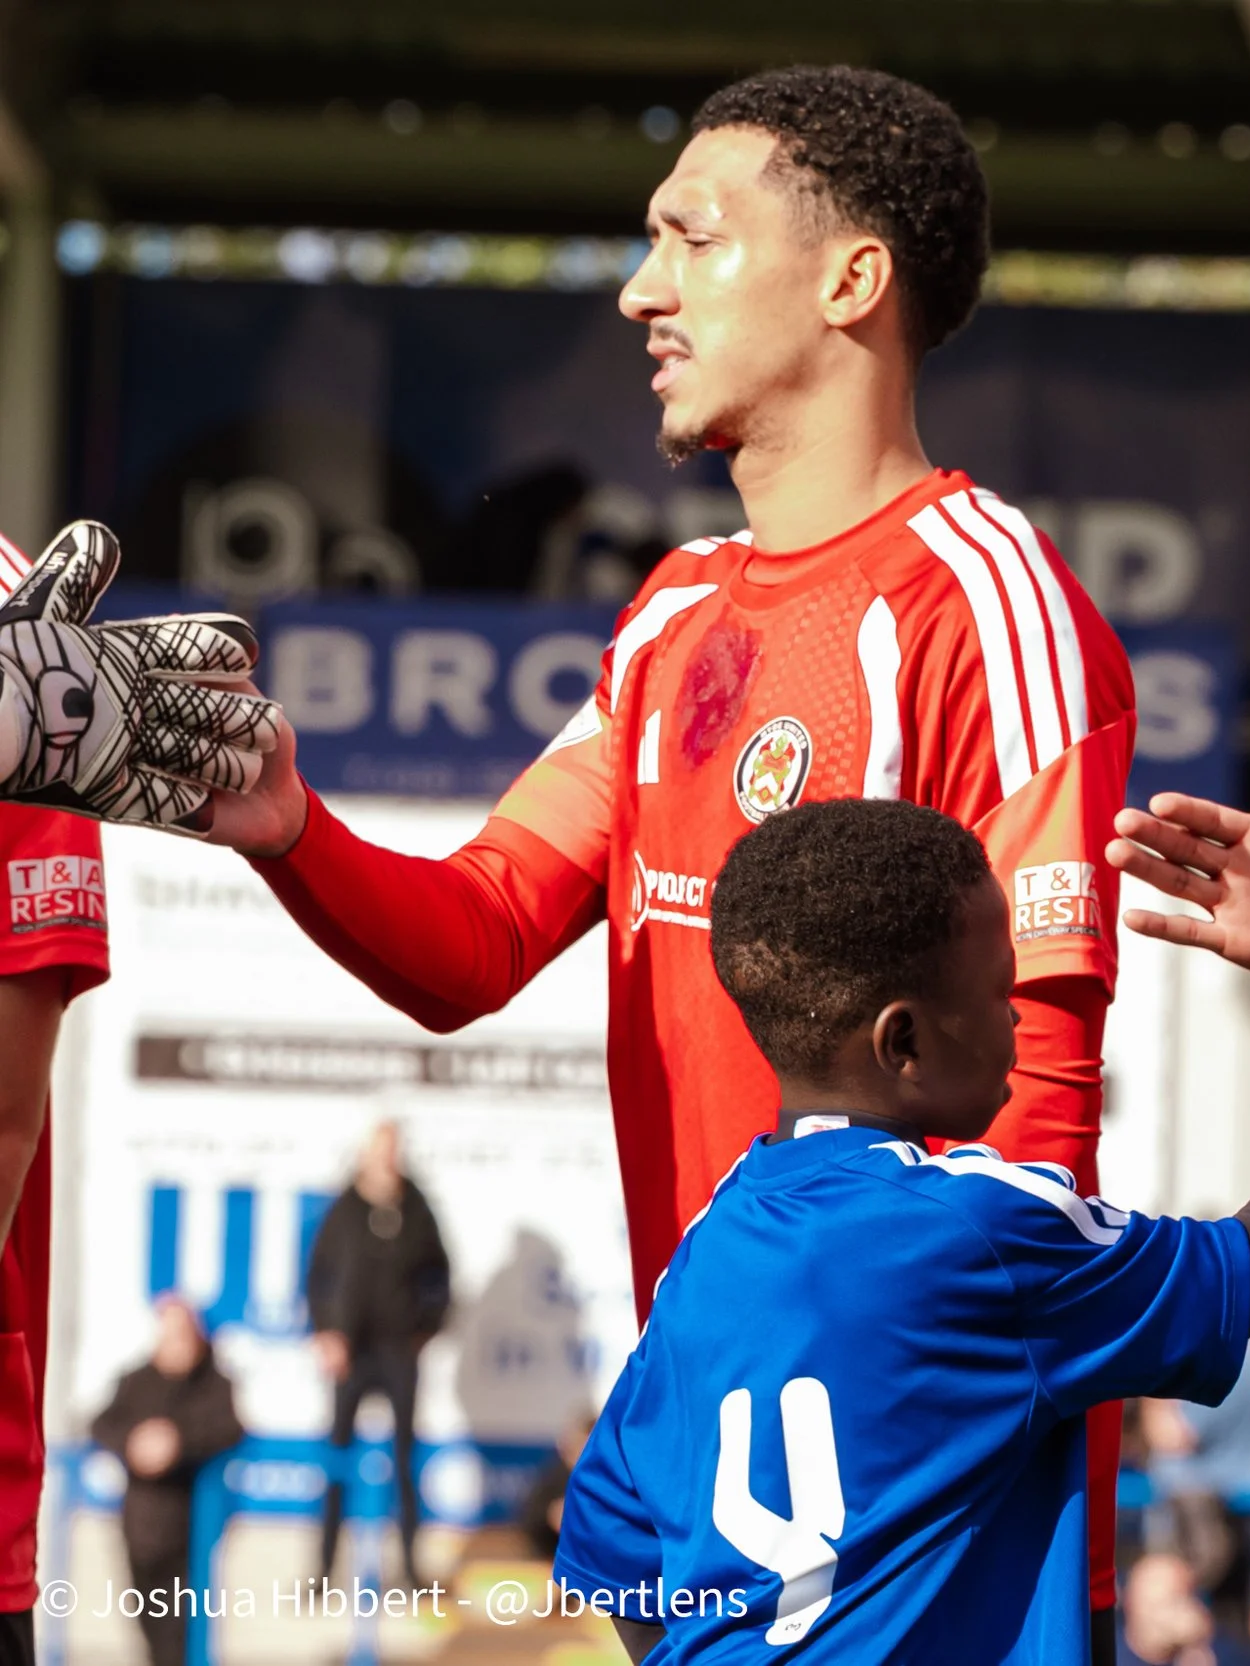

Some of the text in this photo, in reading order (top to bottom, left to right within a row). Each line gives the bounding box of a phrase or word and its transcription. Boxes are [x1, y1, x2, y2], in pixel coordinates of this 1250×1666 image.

[11, 889, 106, 923] RESIN
[1015, 897, 1101, 933] RESIN
[712, 1376, 846, 1646] 4
